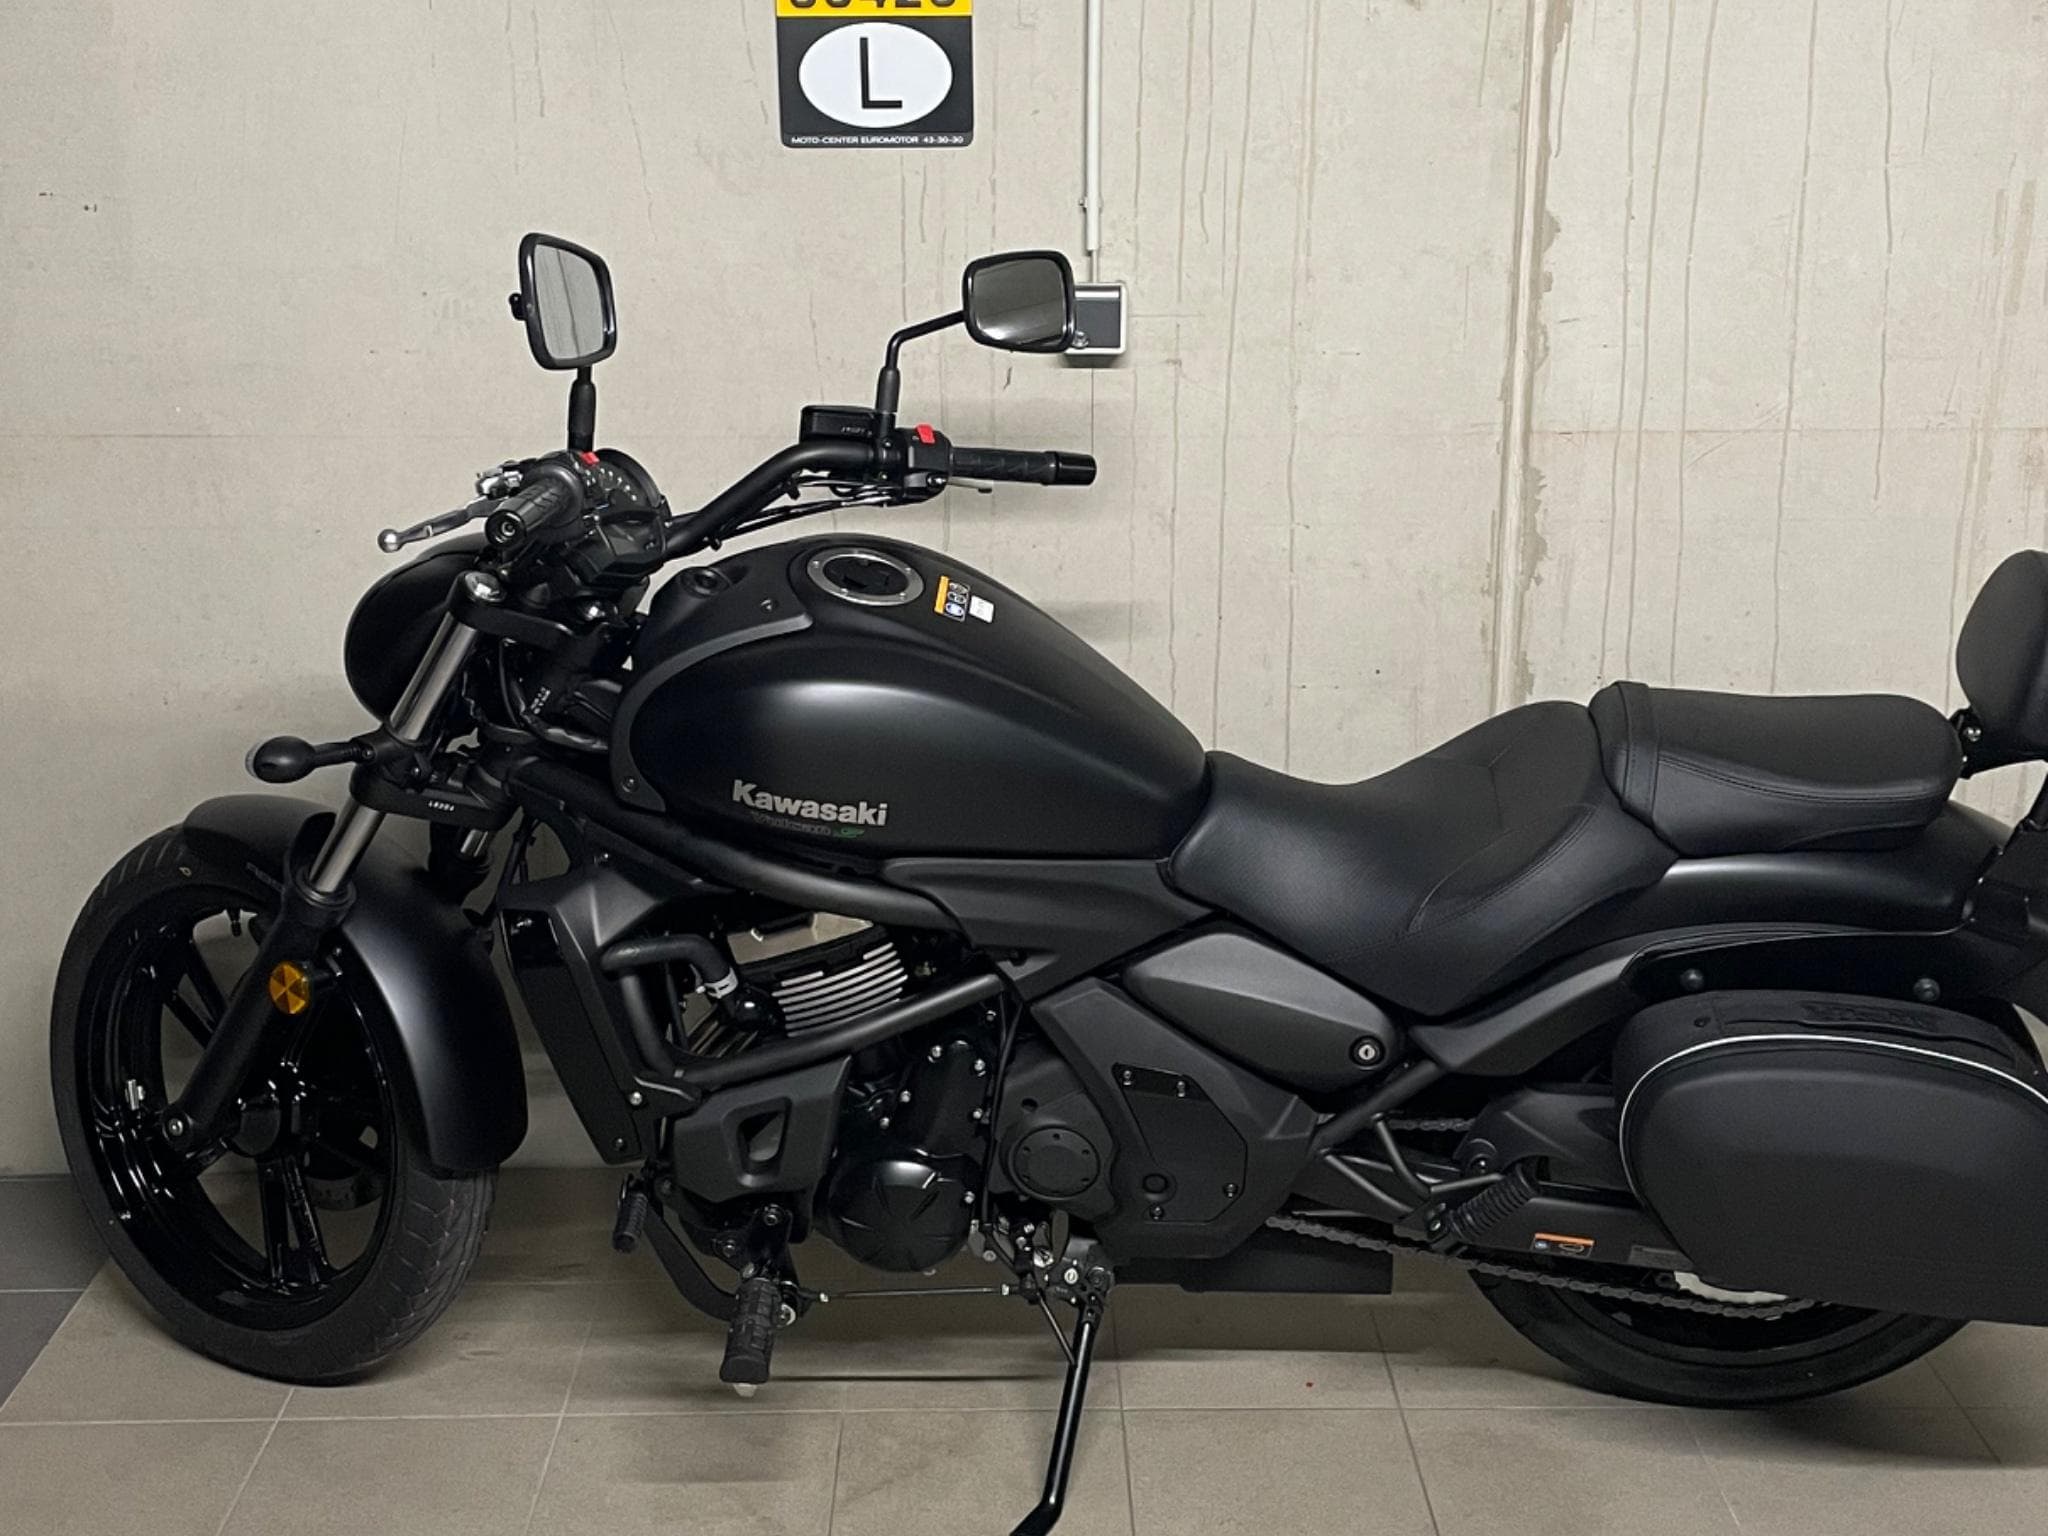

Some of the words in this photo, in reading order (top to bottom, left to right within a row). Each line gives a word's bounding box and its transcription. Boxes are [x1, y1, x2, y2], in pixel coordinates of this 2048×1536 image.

[860, 36, 903, 109] L
[791, 135, 859, 144] MOTO-CENTER
[860, 135, 919, 144] EUROMOTOR
[923, 135, 964, 144] 43-30-30
[732, 779, 888, 826] Kawasaki
